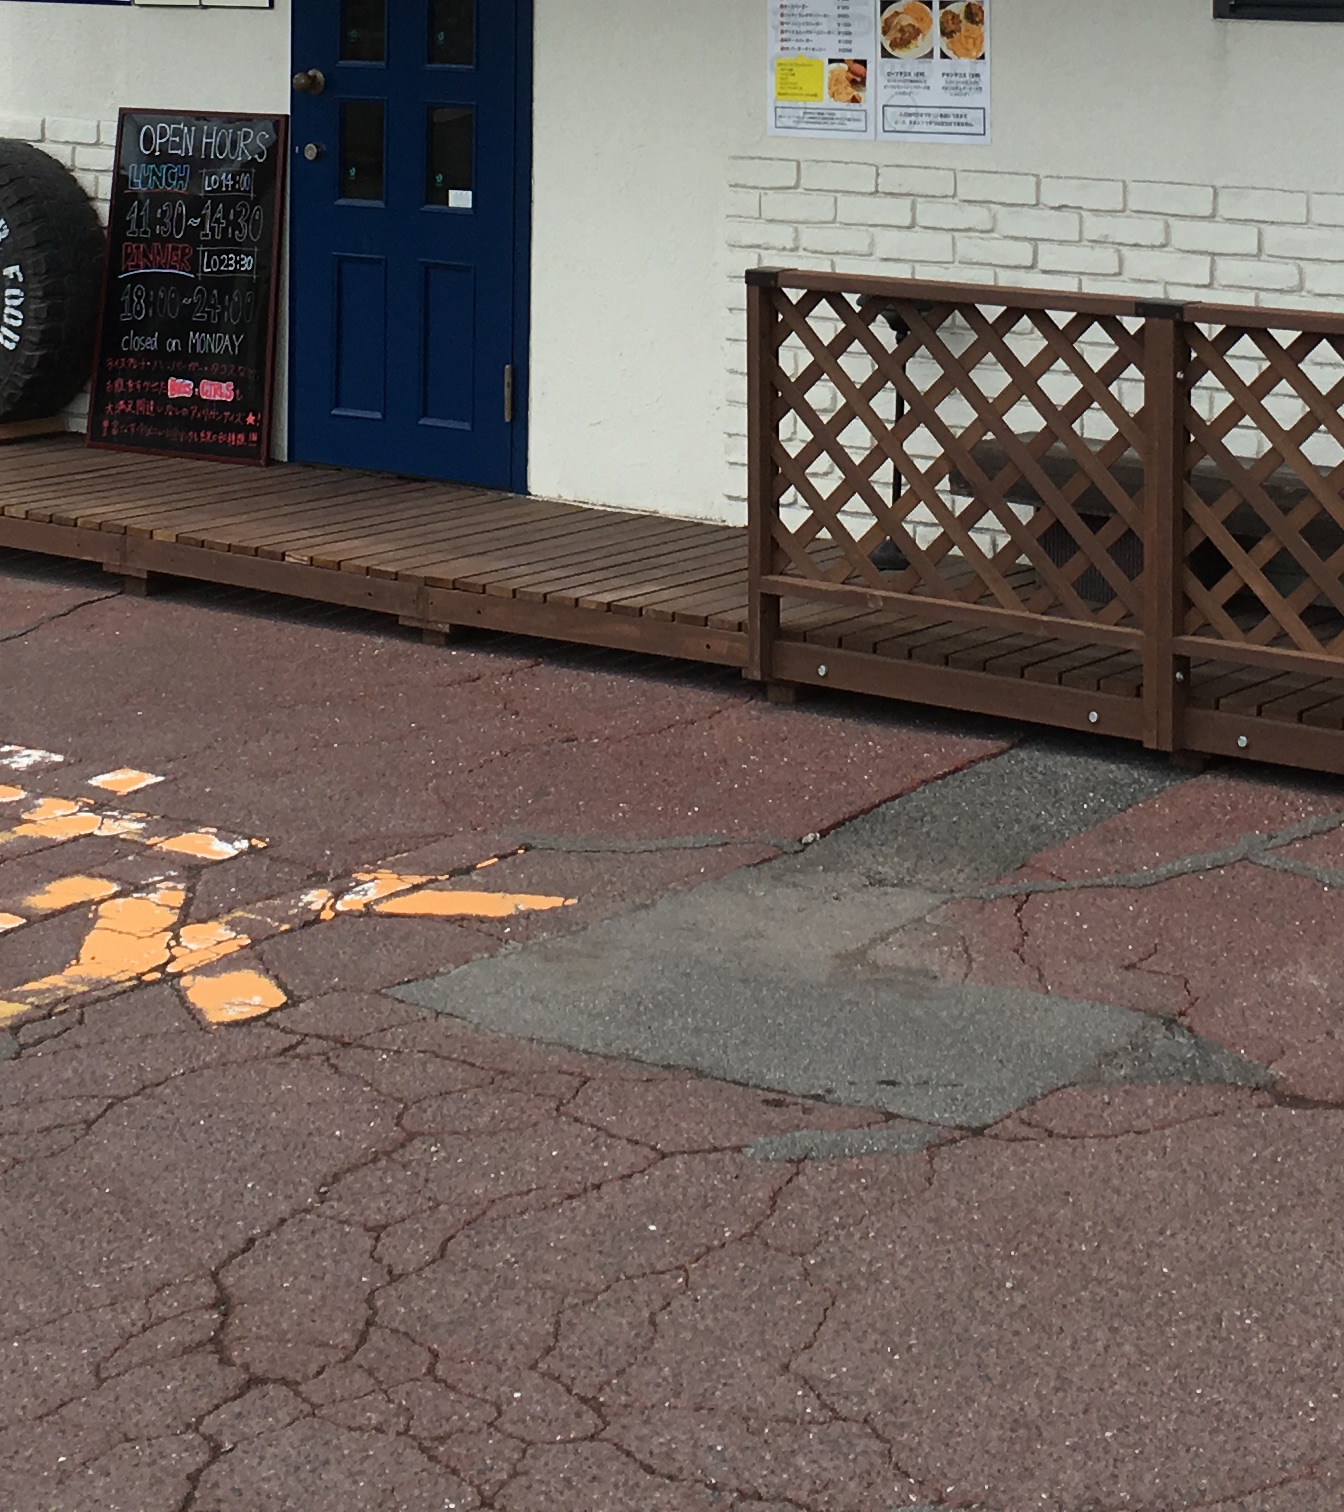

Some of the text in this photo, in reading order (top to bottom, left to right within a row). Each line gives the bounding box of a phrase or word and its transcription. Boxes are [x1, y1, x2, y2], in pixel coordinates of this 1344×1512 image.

[139, 122, 269, 163] OPEN HOURS
[128, 163, 190, 191] LUNCH
[121, 330, 244, 355] closed on MONDAY
